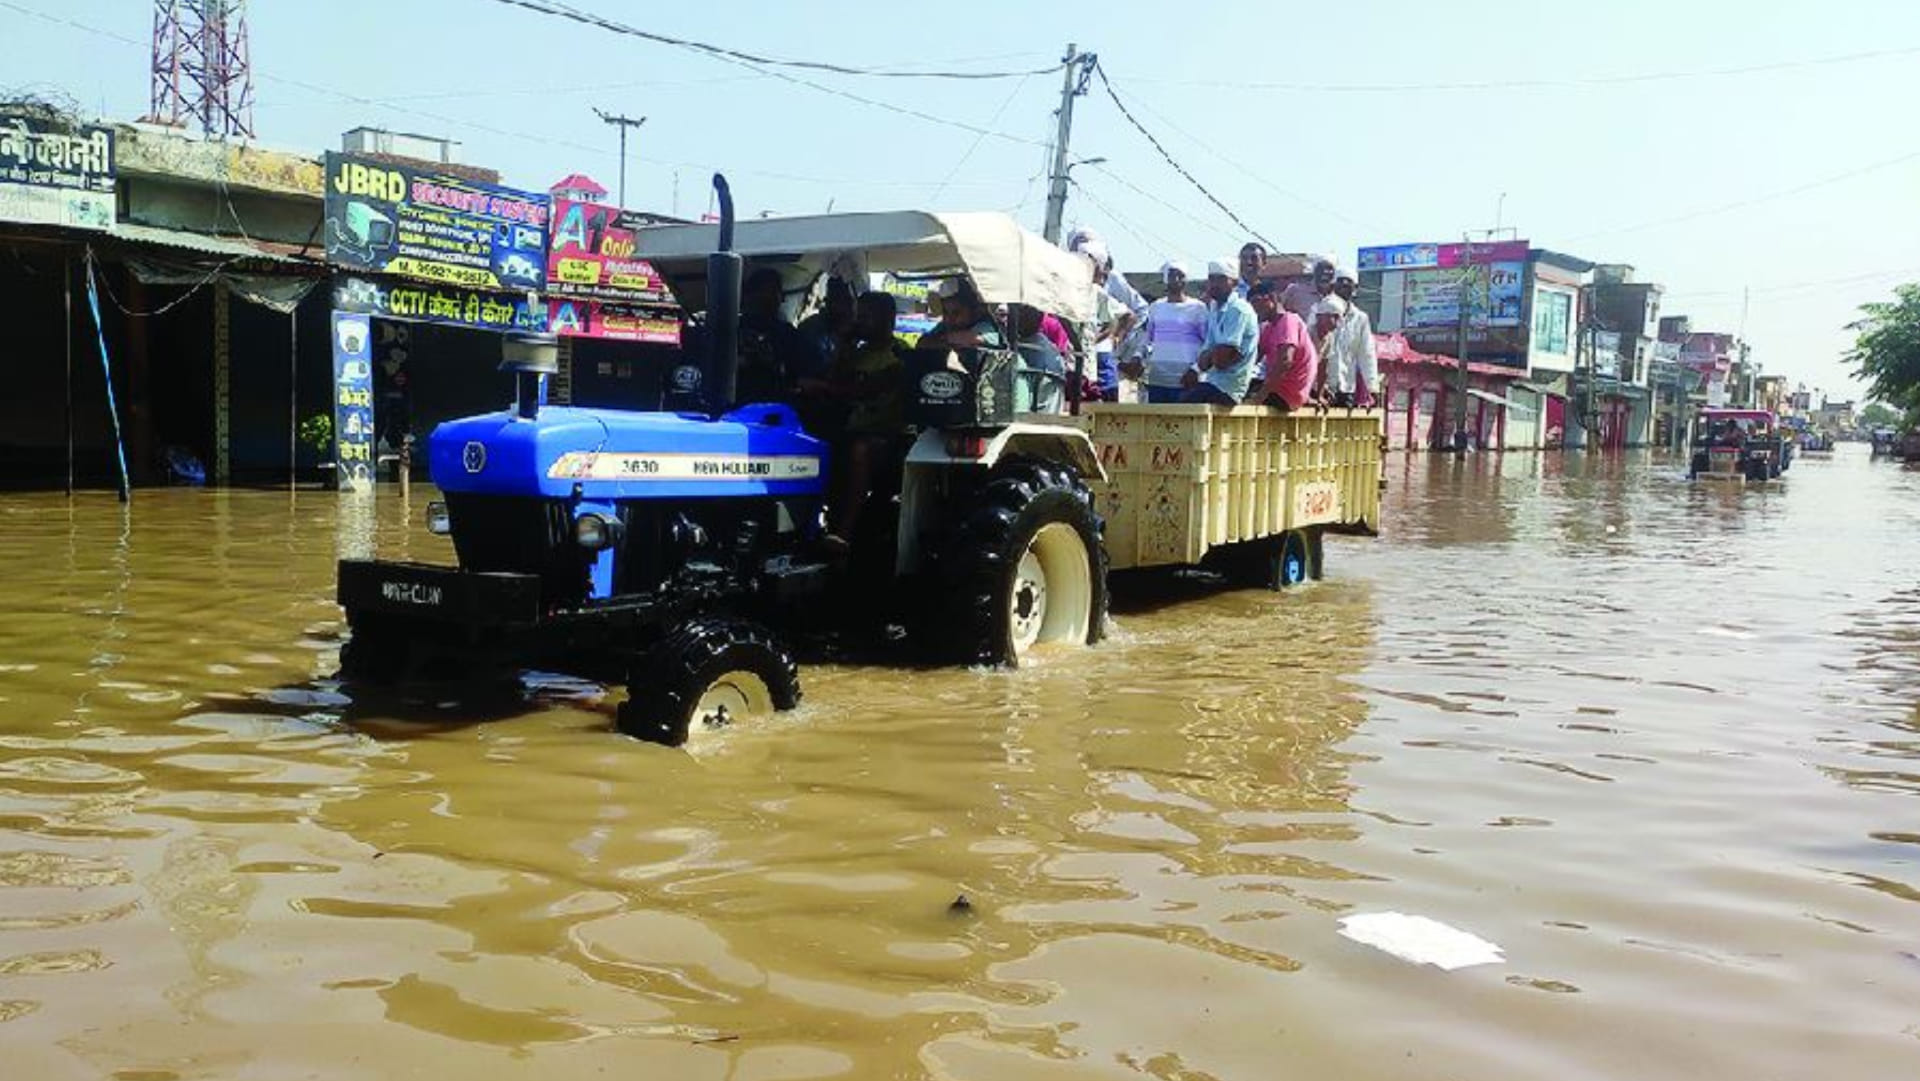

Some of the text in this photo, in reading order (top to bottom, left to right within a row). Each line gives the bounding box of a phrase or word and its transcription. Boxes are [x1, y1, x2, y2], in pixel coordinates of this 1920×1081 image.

[334, 163, 406, 202] JBRD
[552, 204, 608, 254] A1
[391, 288, 427, 315] CCTV
[622, 460, 659, 474] 3630
[693, 461, 770, 475] NEW HOLLAND
